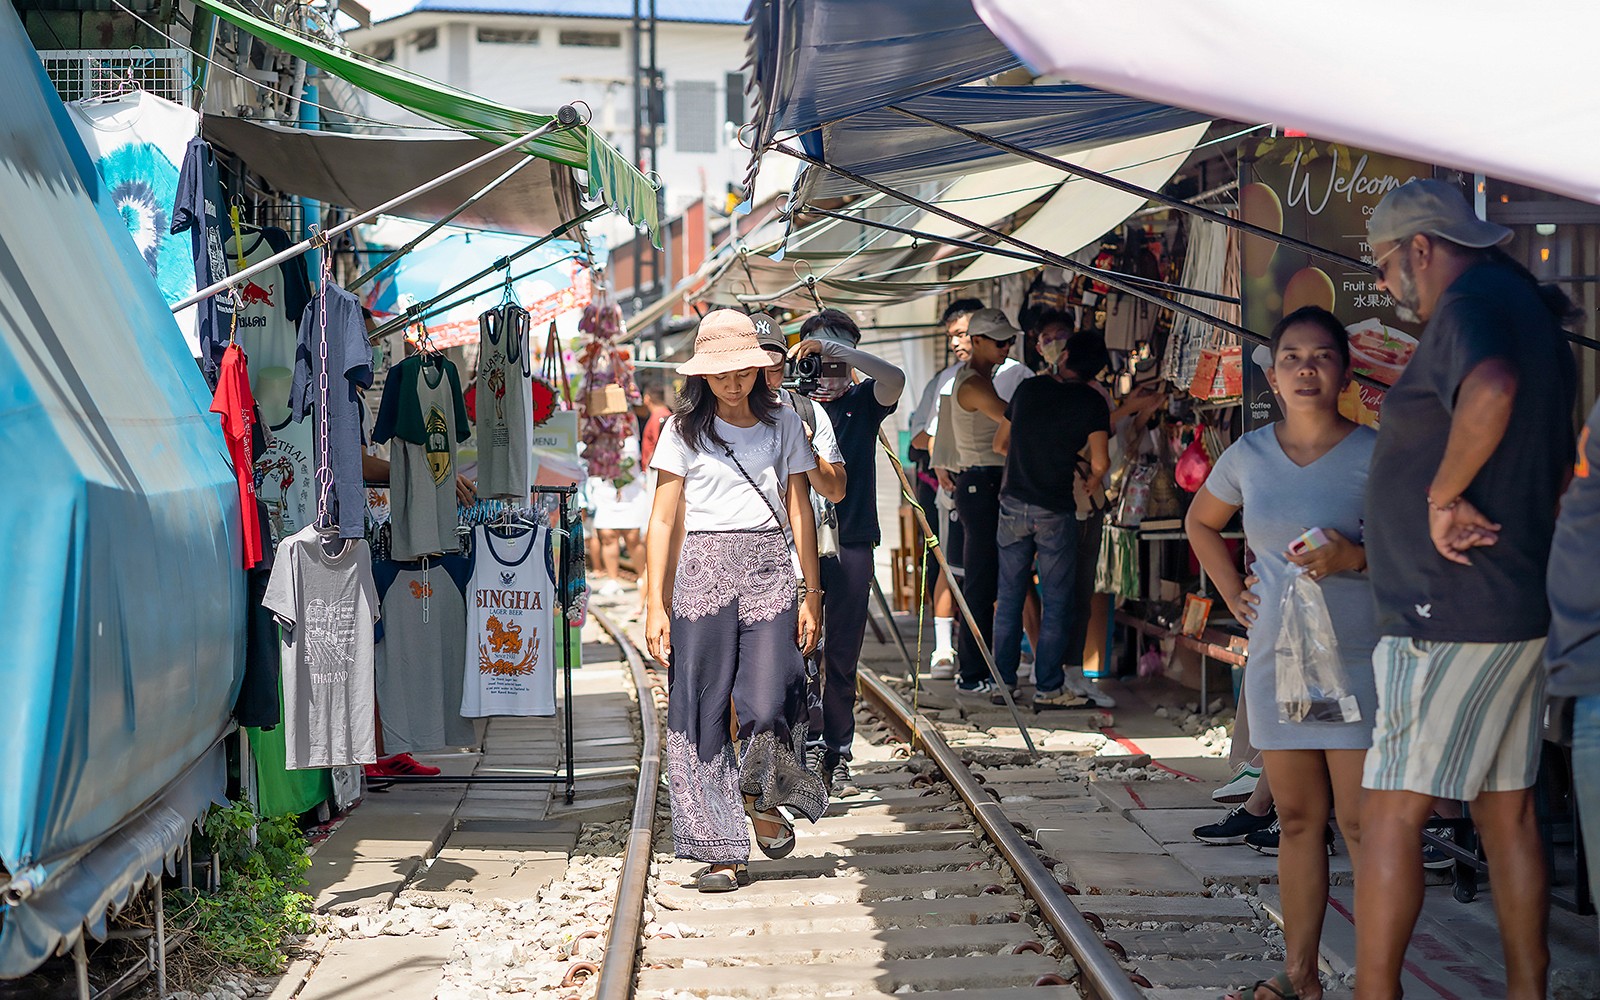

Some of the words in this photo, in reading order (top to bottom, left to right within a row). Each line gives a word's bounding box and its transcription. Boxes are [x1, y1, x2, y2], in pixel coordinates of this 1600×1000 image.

[1343, 281, 1365, 291] Fruit
[1353, 294, 1395, 308] 水果冰
[756, 320, 771, 335] NY
[475, 589, 543, 610] SINGHA
[311, 671, 348, 684] THAILAND
